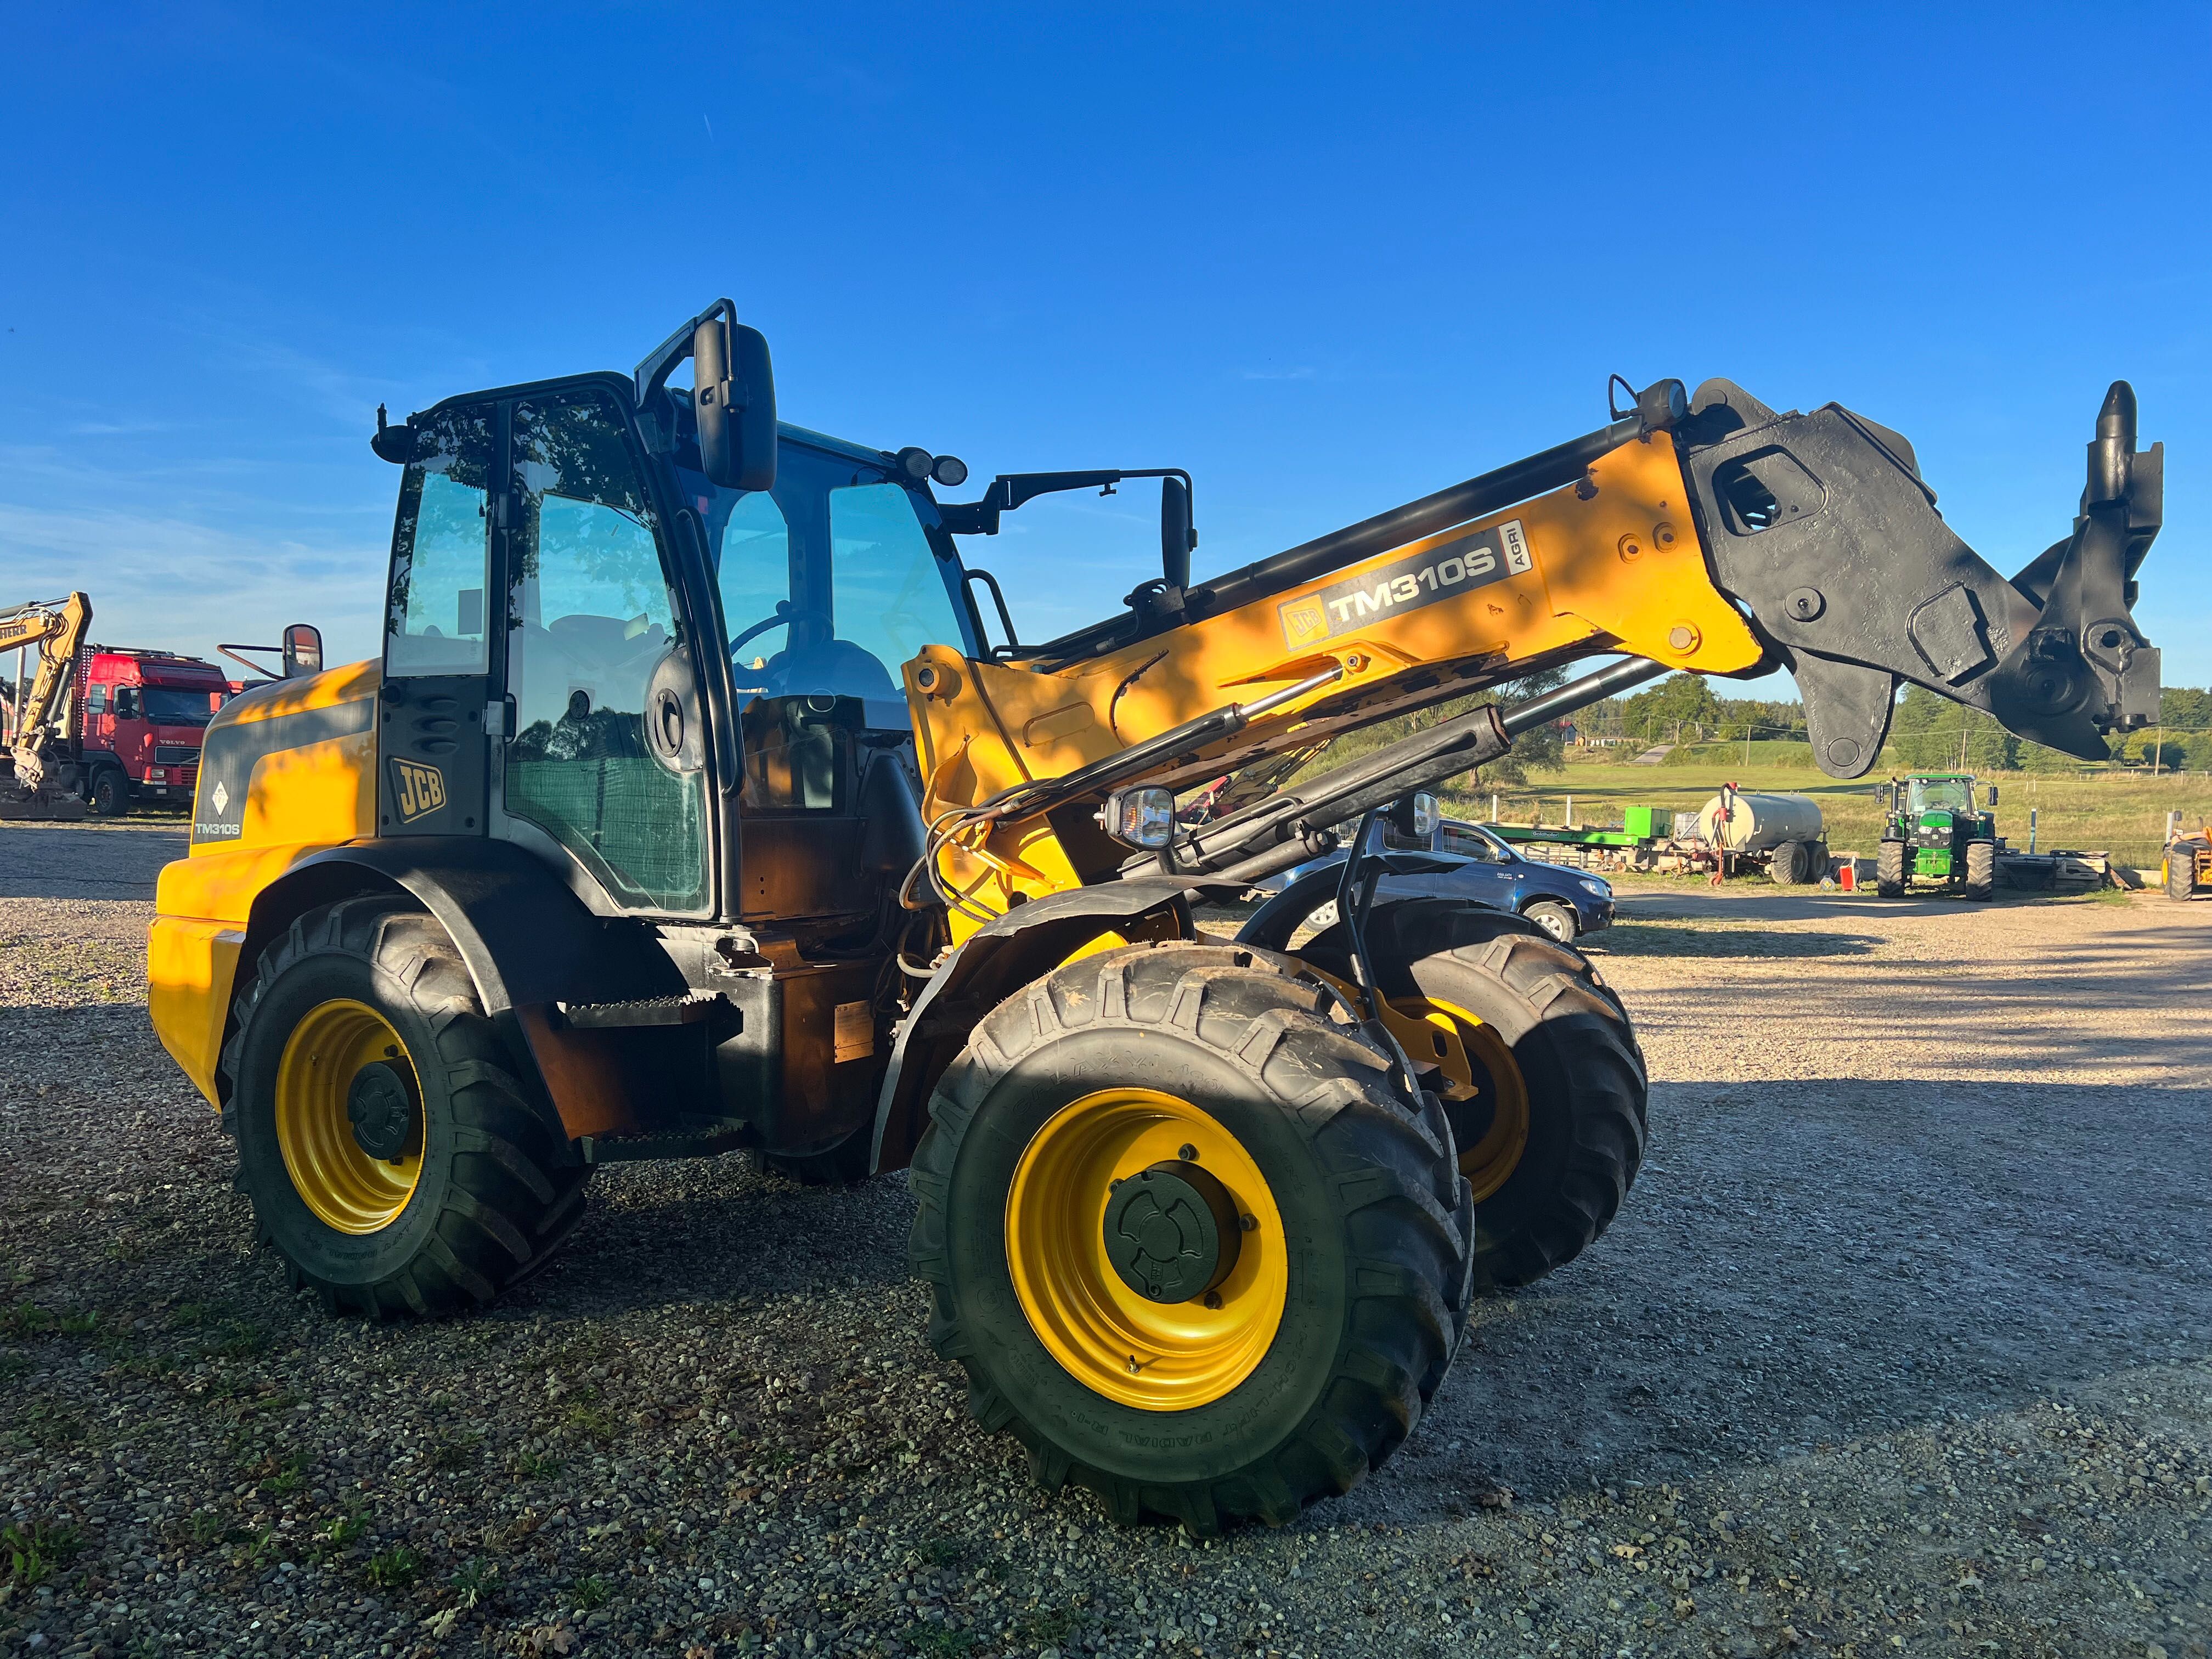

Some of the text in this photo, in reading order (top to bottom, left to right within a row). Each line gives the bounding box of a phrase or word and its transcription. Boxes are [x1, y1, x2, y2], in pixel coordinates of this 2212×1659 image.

[1507, 527, 1525, 566] AGRI
[1329, 547, 1496, 622] TM310S
[1292, 610, 1322, 631] JCB
[399, 765, 442, 816] JCB
[195, 823, 240, 835] TM310S
[1117, 1429, 1213, 1449] RADIAL
